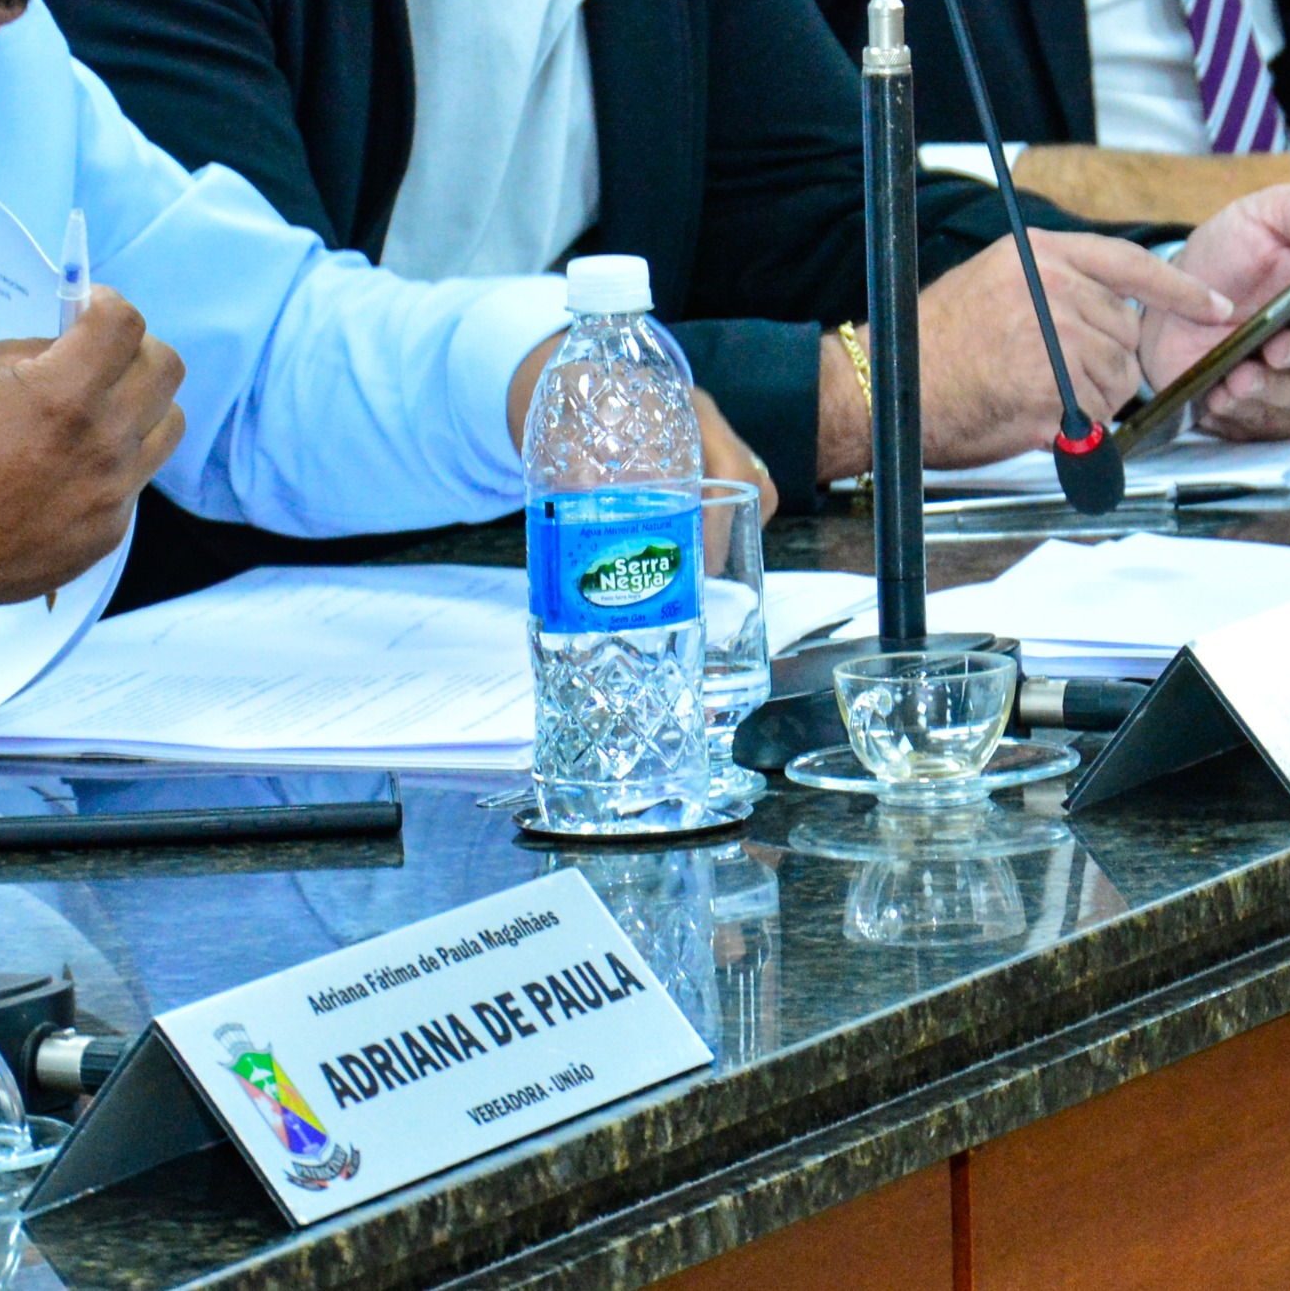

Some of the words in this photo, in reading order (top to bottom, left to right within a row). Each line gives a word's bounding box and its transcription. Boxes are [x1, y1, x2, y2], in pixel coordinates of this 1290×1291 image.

[604, 523, 639, 536] Mineral
[642, 519, 672, 532] Natural
[599, 570, 665, 593] Negra
[614, 556, 670, 576] Serra
[307, 982, 369, 1016] Adriana
[363, 963, 421, 994] Fátima
[418, 953, 441, 974] de
[436, 938, 483, 966] Paula
[478, 910, 560, 947] Magalhães
[319, 1013, 488, 1109] ADRIANA
[471, 992, 538, 1047] DE
[521, 951, 646, 1027] PAULA
[467, 1082, 550, 1126] VEREADORA
[550, 1063, 595, 1093] UNIÃO
